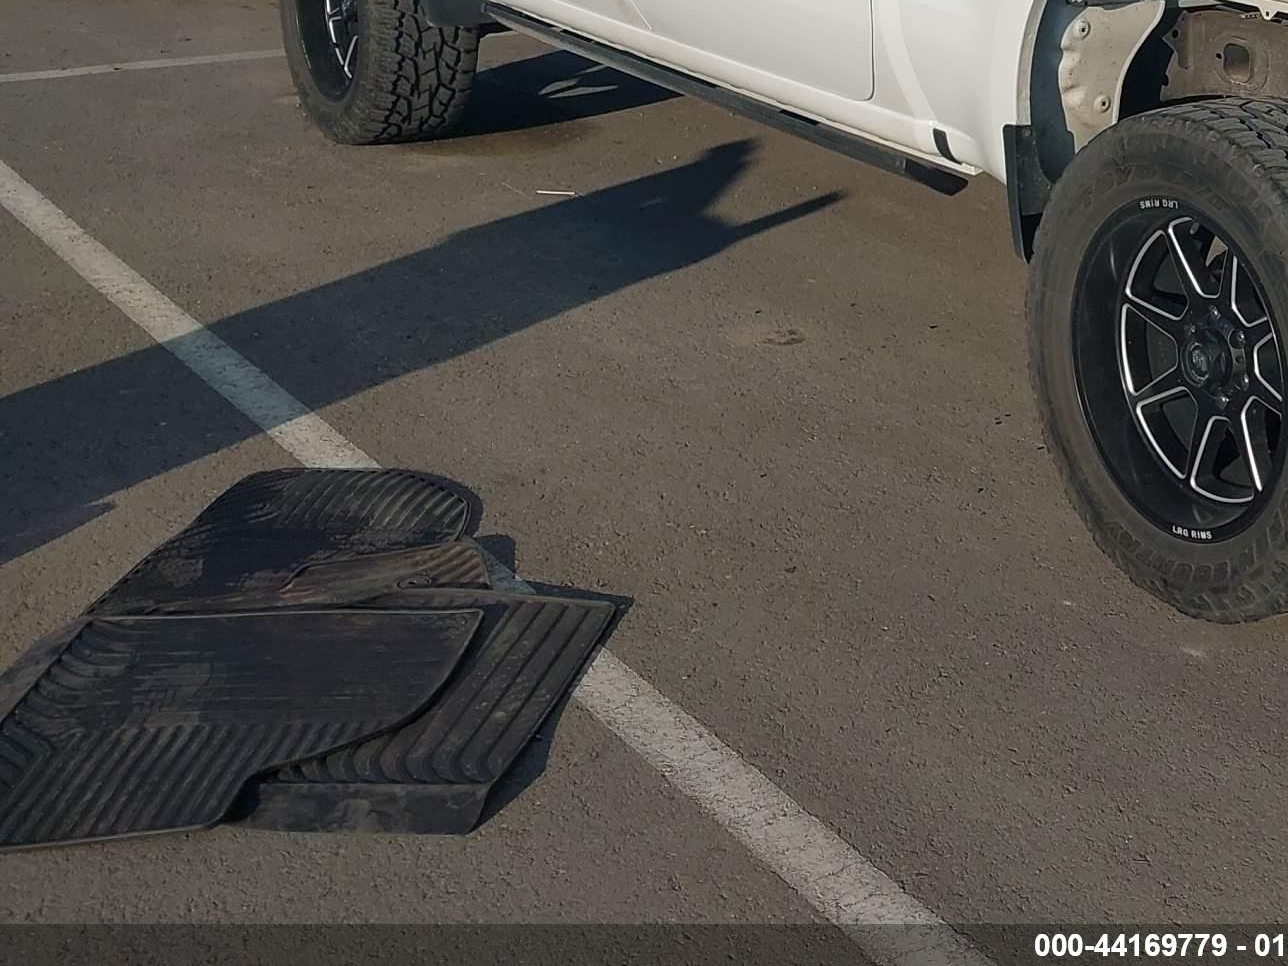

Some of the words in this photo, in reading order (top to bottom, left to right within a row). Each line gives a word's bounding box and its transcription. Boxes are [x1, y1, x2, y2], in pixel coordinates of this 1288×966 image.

[1162, 199, 1179, 210] LRG
[1172, 524, 1189, 538] LRG
[1190, 529, 1213, 540] RIMS
